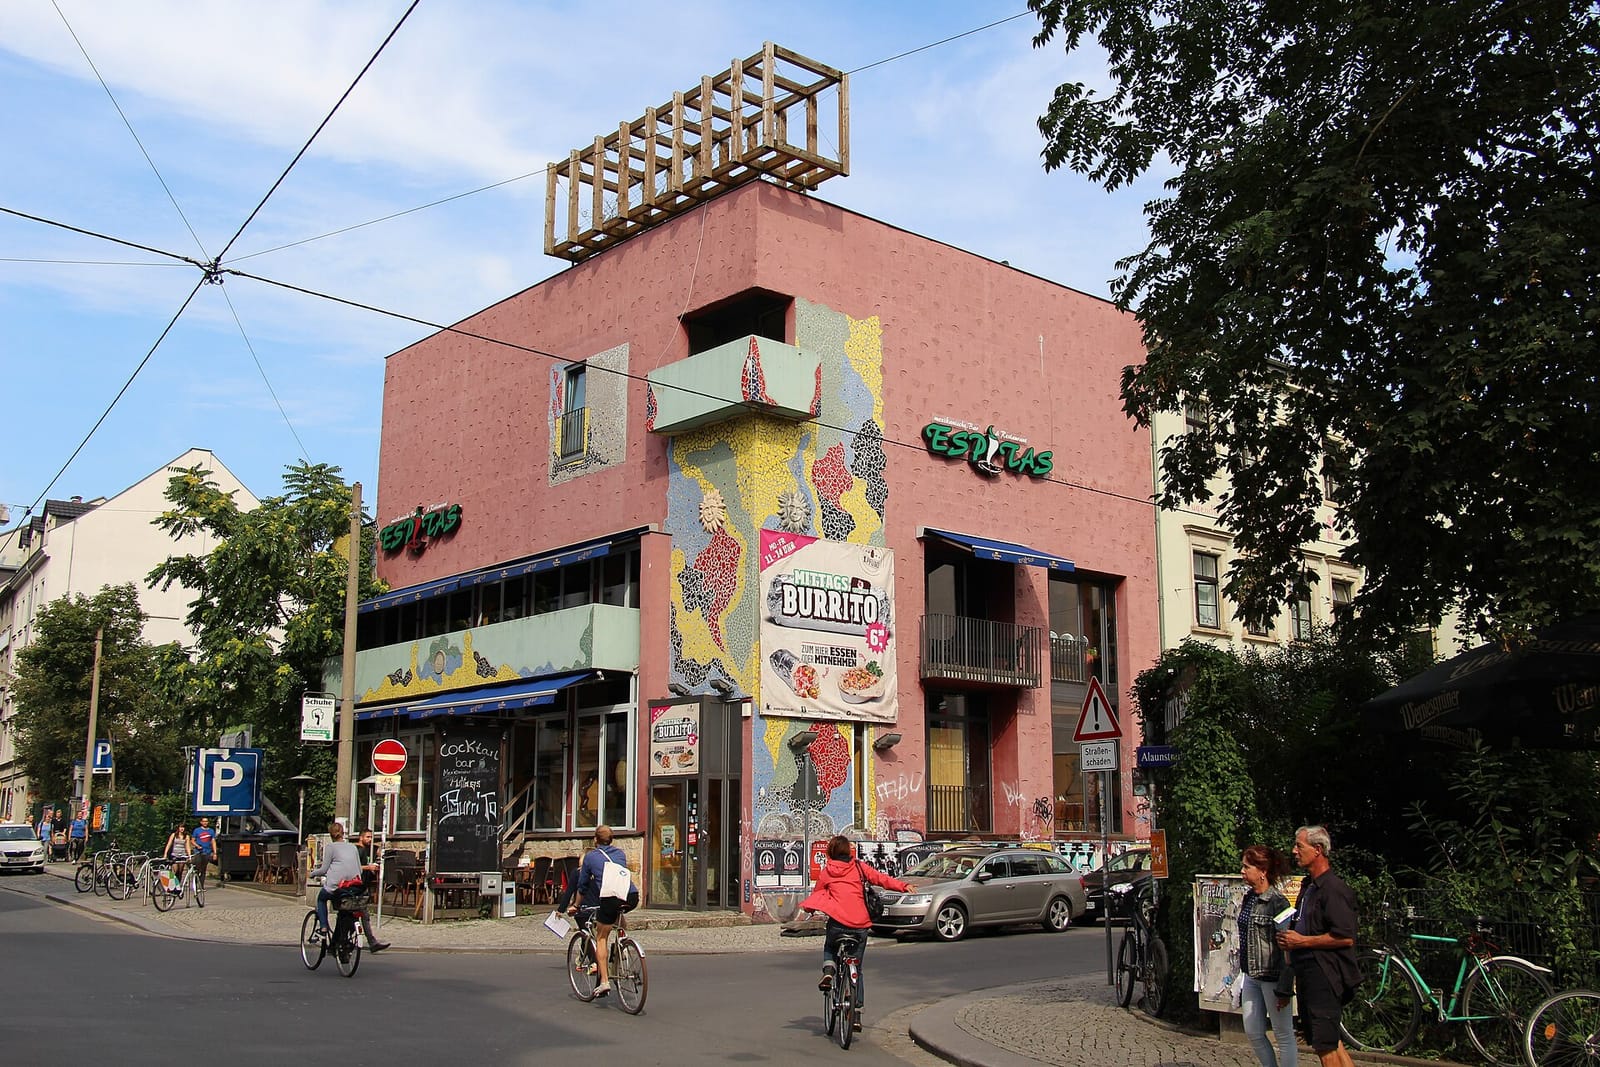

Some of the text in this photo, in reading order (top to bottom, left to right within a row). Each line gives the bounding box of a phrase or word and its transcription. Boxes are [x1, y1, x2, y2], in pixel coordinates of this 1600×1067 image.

[924, 423, 1054, 475] ESPITAS
[380, 504, 462, 550] ESPITAS
[793, 569, 849, 592] MITTAGS
[781, 583, 879, 625] BURRITO
[801, 644, 857, 659] ZUM HIER ESSEN
[815, 654, 857, 668] MITNEHMEN
[658, 723, 692, 738] BURRITO
[96, 743, 110, 765] P
[1085, 747, 1112, 756] Straßen-
[1086, 758, 1112, 767] schäden
[211, 761, 243, 802] P
